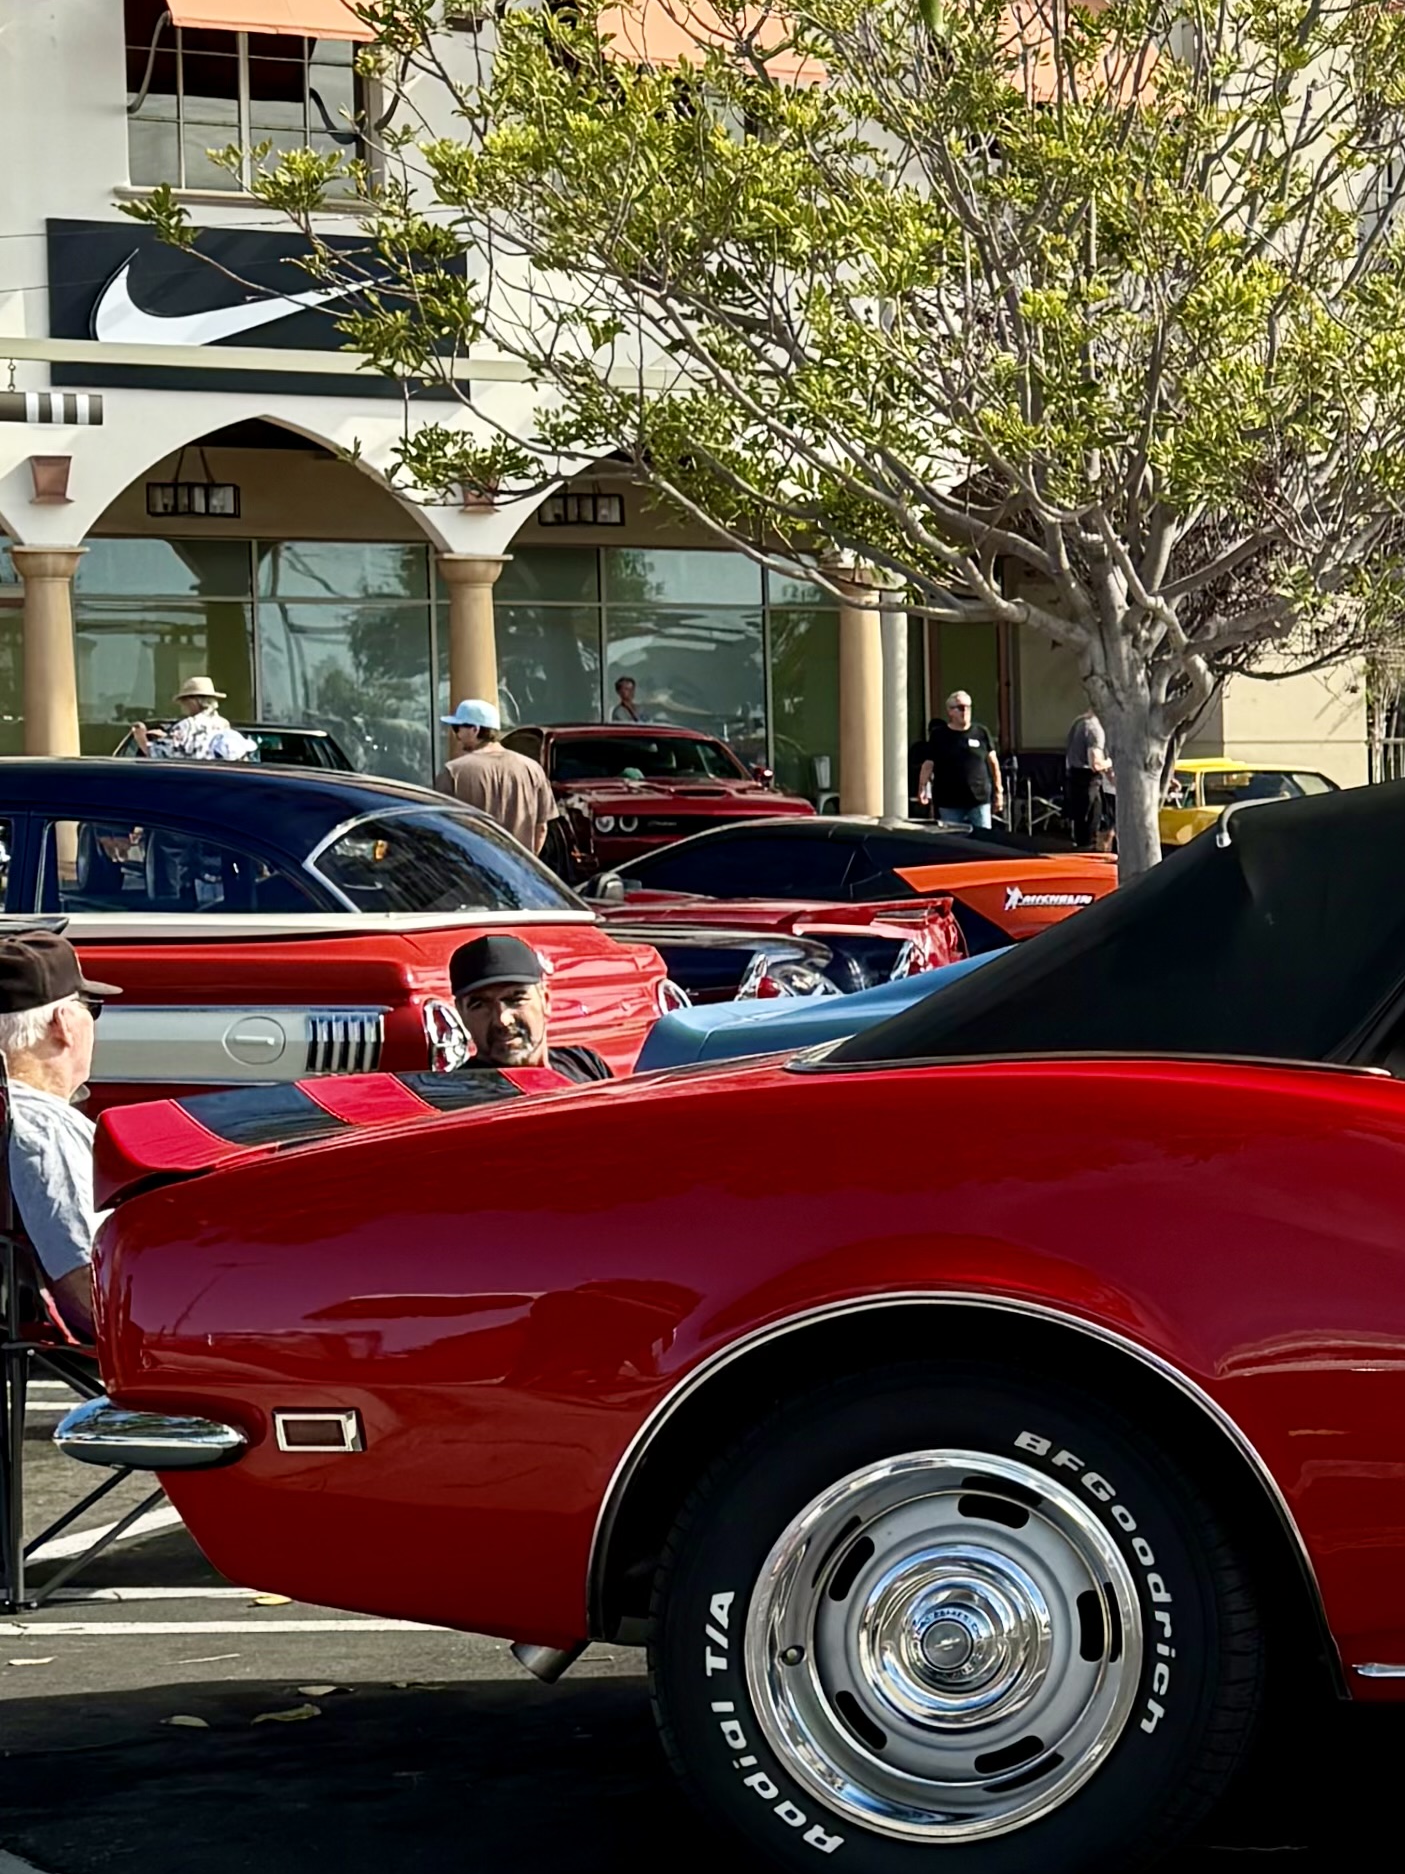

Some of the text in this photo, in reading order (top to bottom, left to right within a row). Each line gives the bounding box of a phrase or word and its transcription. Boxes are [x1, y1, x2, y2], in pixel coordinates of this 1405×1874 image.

[705, 1591, 844, 1854] Radial T/A
[1013, 1430, 1176, 1734] BFGoodrich
